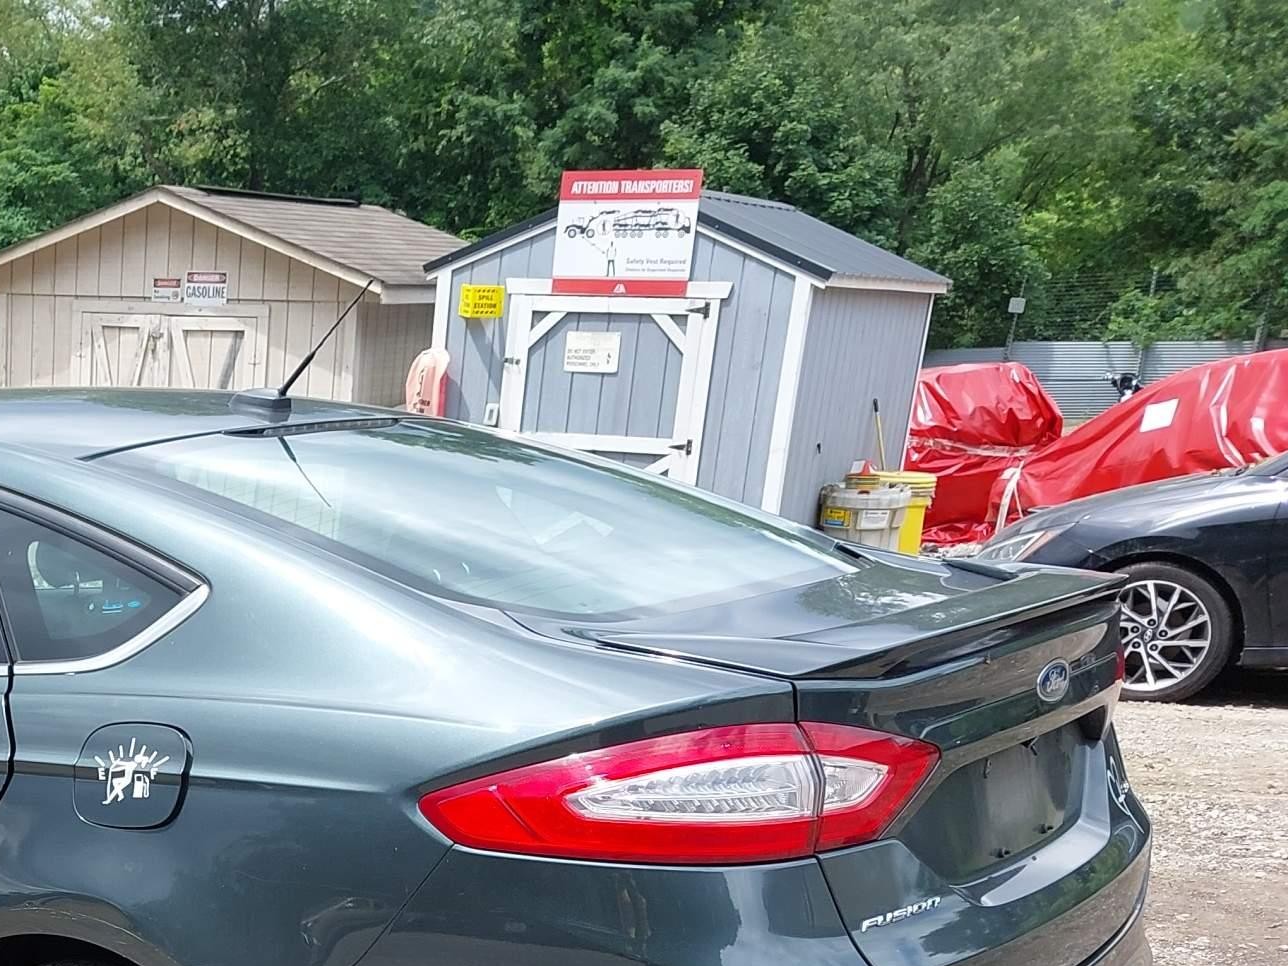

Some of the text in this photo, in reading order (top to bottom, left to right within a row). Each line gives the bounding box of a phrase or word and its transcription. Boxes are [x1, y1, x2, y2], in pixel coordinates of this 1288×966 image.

[571, 180, 693, 194] ATTENTION TRANSPORTERS!
[626, 257, 644, 267] Safety
[660, 257, 686, 266] Required
[186, 286, 227, 299] GASOLINE
[861, 896, 941, 932] FUSION
